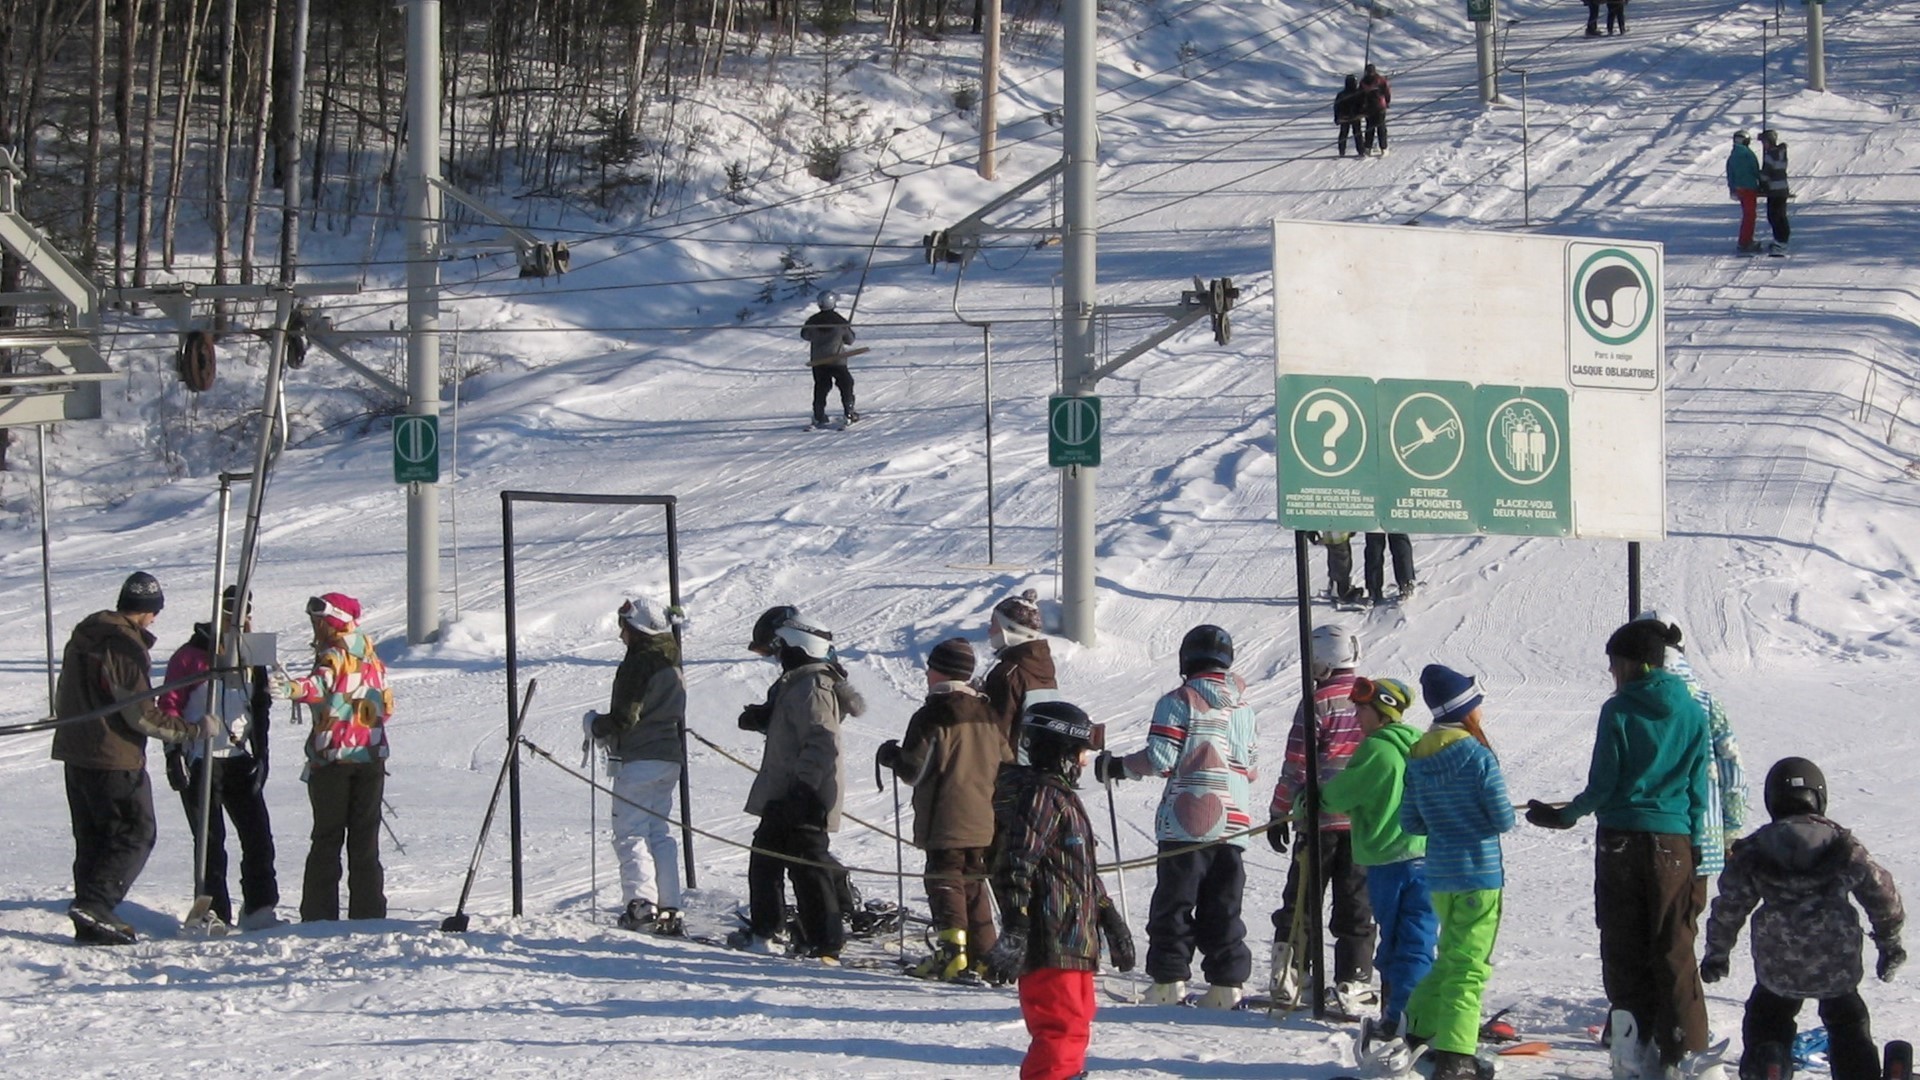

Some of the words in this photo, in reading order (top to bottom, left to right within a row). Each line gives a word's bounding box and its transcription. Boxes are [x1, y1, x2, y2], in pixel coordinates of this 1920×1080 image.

[1594, 351, 1608, 359] Parc
[1572, 365, 1603, 376] CASQUE
[1605, 367, 1655, 379] OBLIGATOIRE
[1410, 487, 1449, 498] RETIREZ
[1396, 498, 1414, 507] LES
[1416, 498, 1462, 509] POIGNETS
[1496, 499, 1553, 509] PLACEZ-VOUS
[1390, 509, 1409, 518] DES
[1411, 509, 1469, 520] DRAGONNES
[1493, 508, 1515, 518] DEUX
[1517, 508, 1533, 518] PAR
[1535, 510, 1557, 519] DEUX
